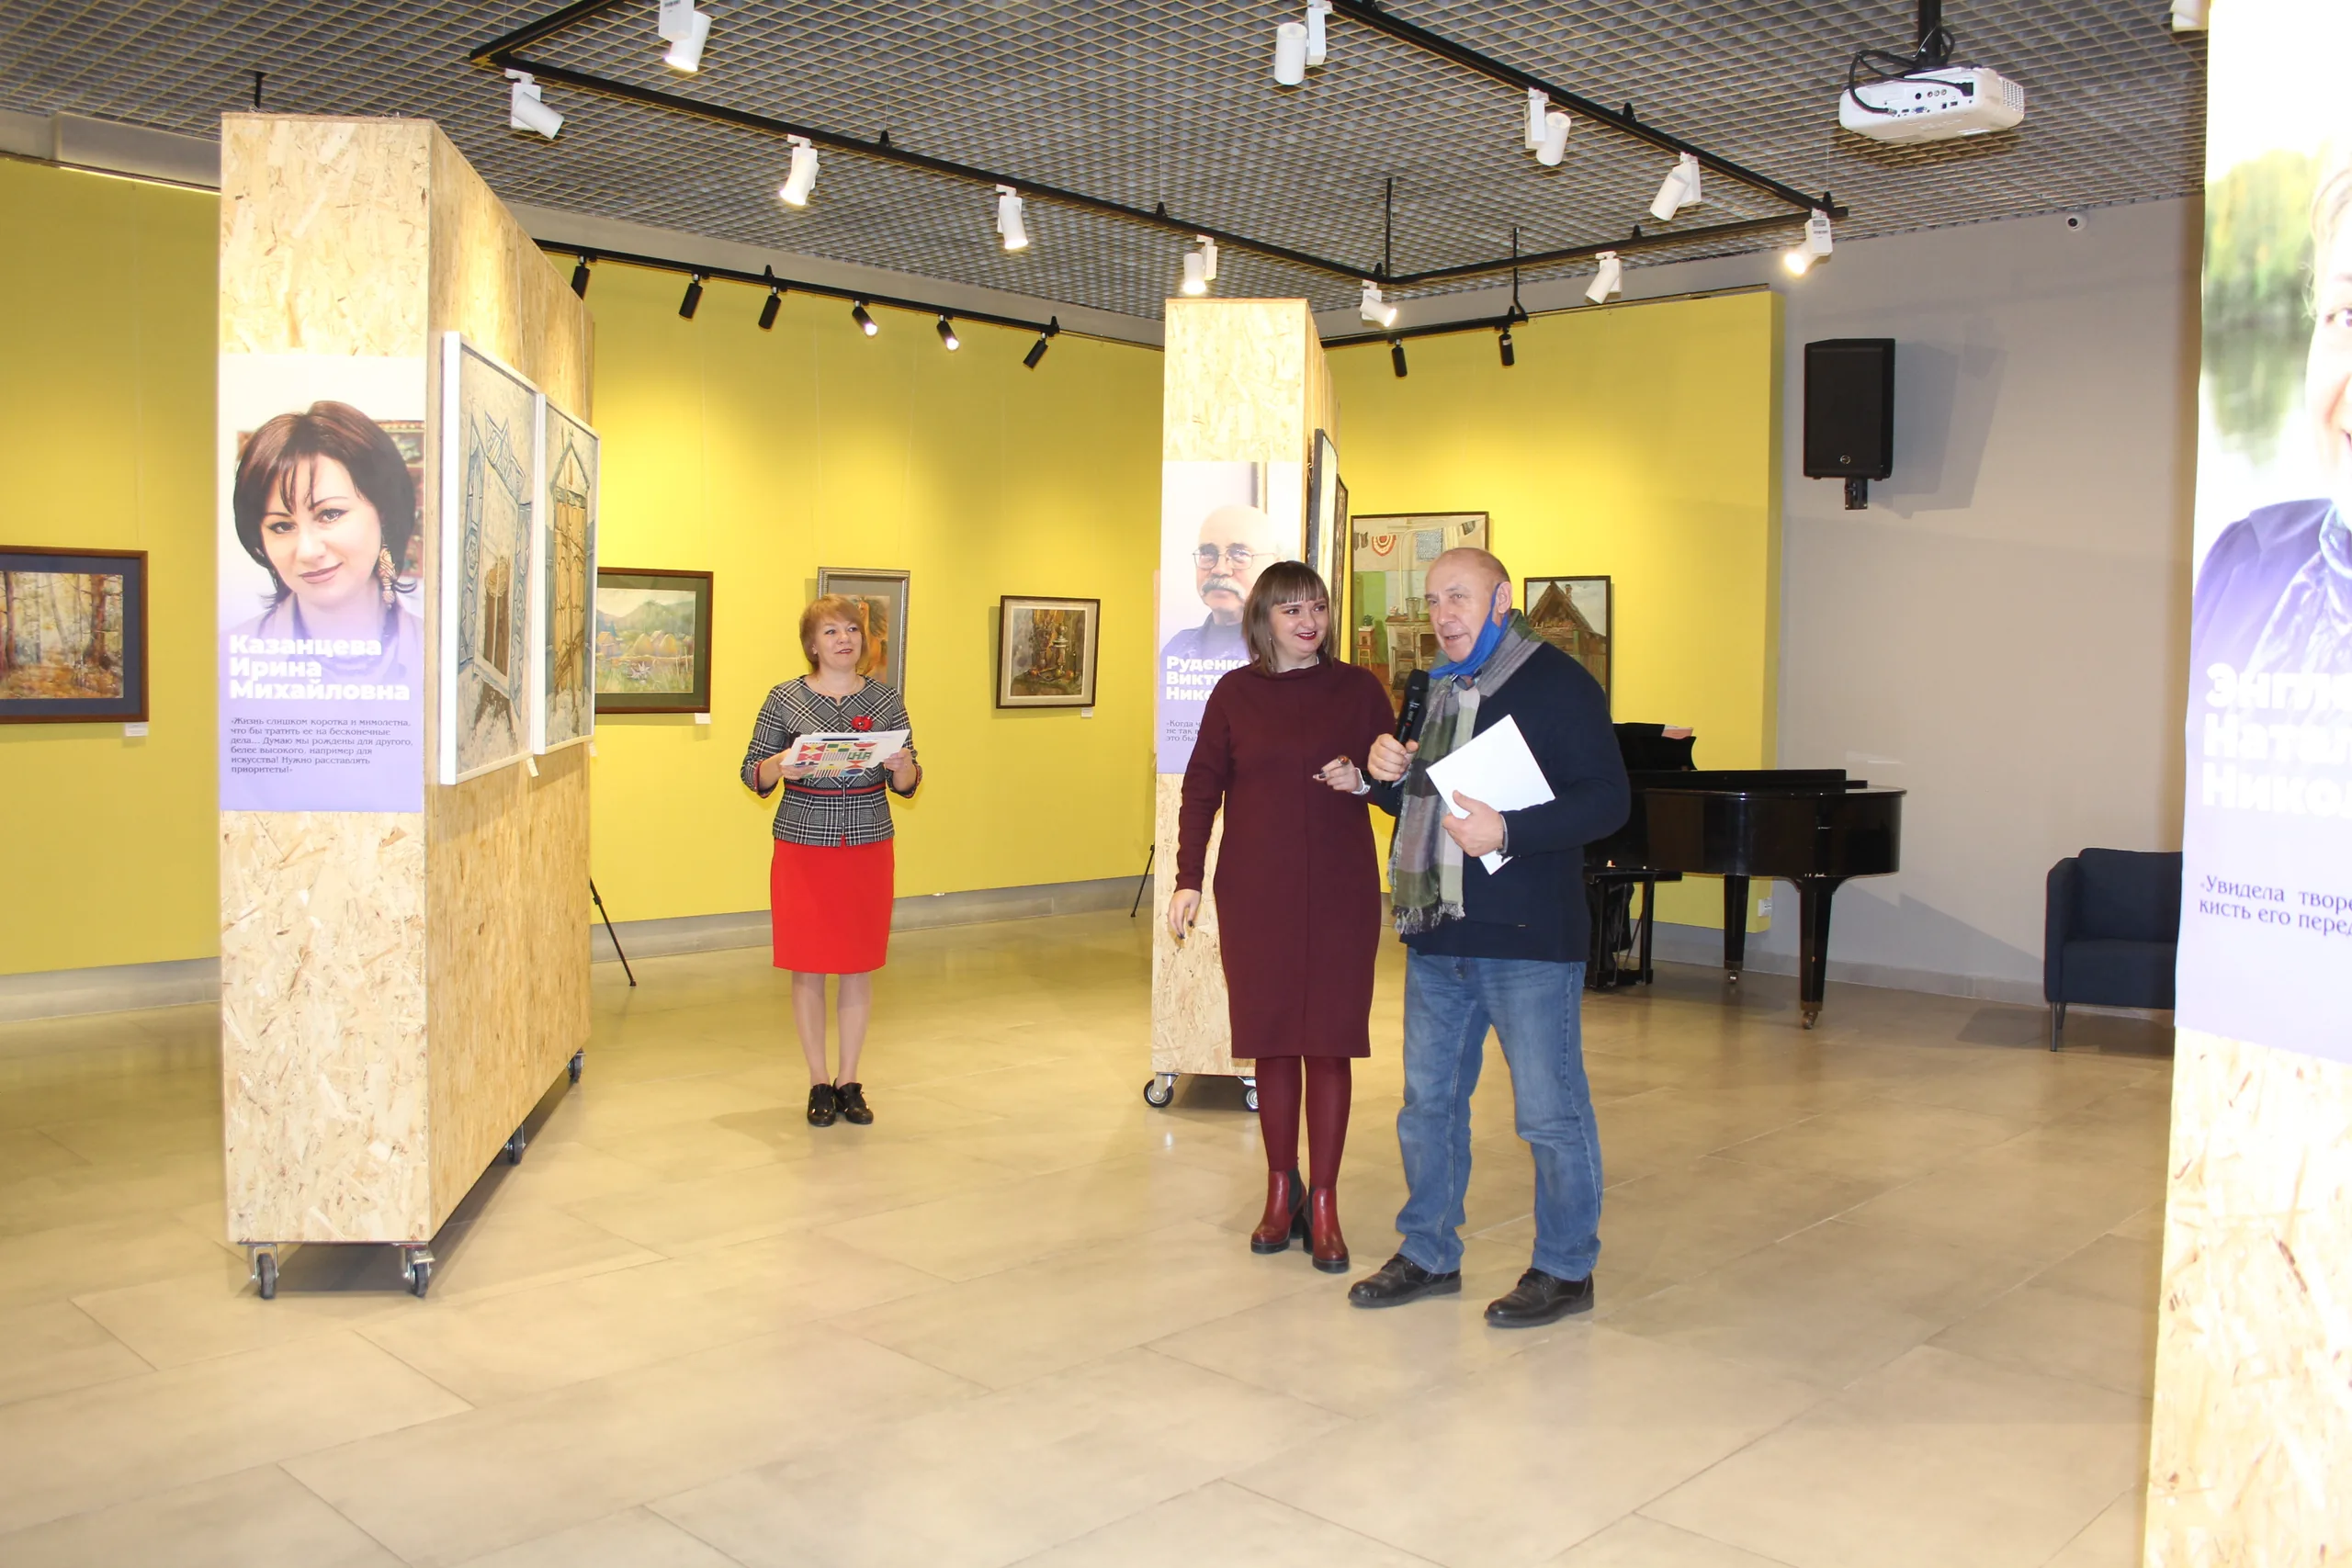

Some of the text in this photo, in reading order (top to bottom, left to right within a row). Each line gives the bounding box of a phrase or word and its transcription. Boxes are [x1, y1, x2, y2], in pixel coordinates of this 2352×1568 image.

[230, 635, 381, 658] Казанцева
[230, 657, 322, 681] Ирина
[230, 679, 410, 701] Михайловна
[311, 718, 348, 727] коротка
[249, 727, 262, 735] бы
[266, 728, 300, 737] тратить
[330, 728, 390, 736] бесконечные
[263, 737, 292, 745] Думаю
[312, 738, 355, 746] рождены
[310, 748, 354, 756] например
[231, 756, 370, 765] искусства! Нужно расставлять
[2199, 899, 2251, 919] кисть
[2258, 908, 2290, 925] его
